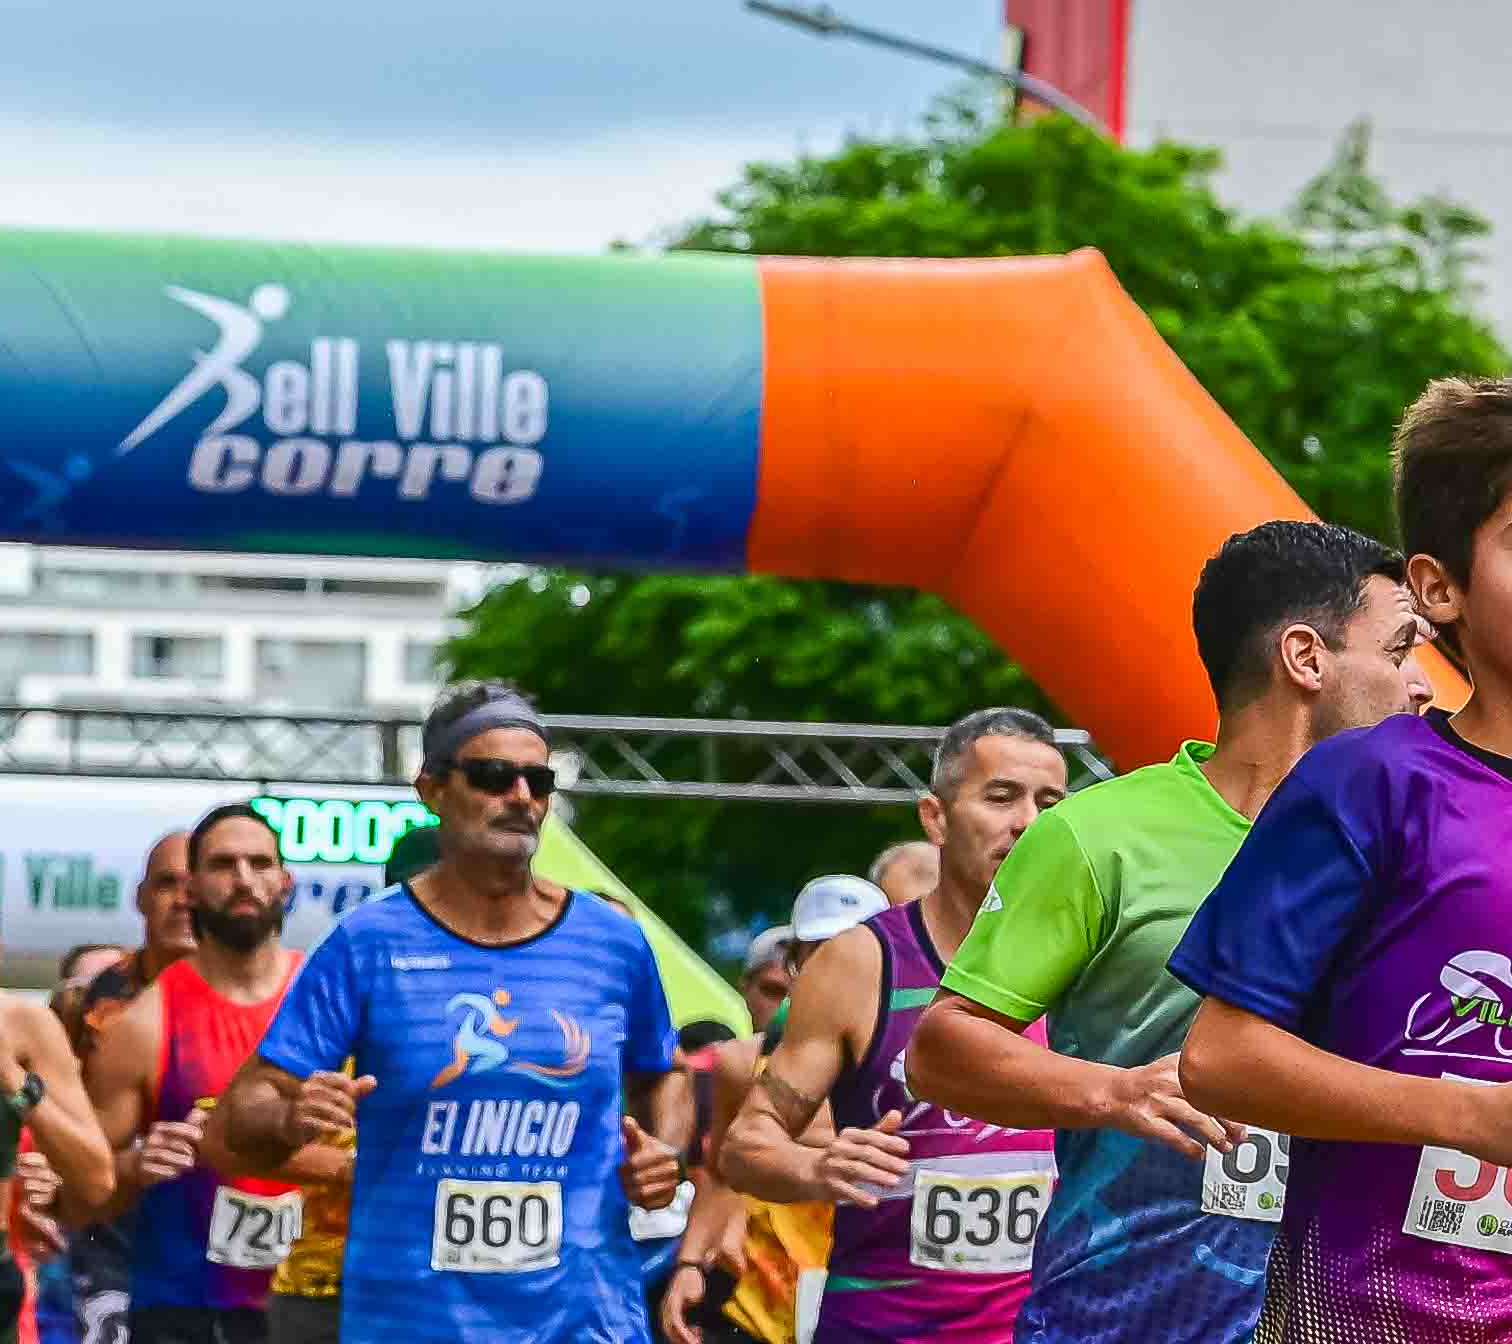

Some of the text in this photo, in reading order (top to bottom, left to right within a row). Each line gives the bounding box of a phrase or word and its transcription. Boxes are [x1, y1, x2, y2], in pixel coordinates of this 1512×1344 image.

[387, 339, 550, 445] Ville
[187, 435, 545, 505] corre
[460, 1099, 581, 1158] INICIO
[444, 1192, 549, 1249] 660
[925, 1184, 1041, 1246] 636
